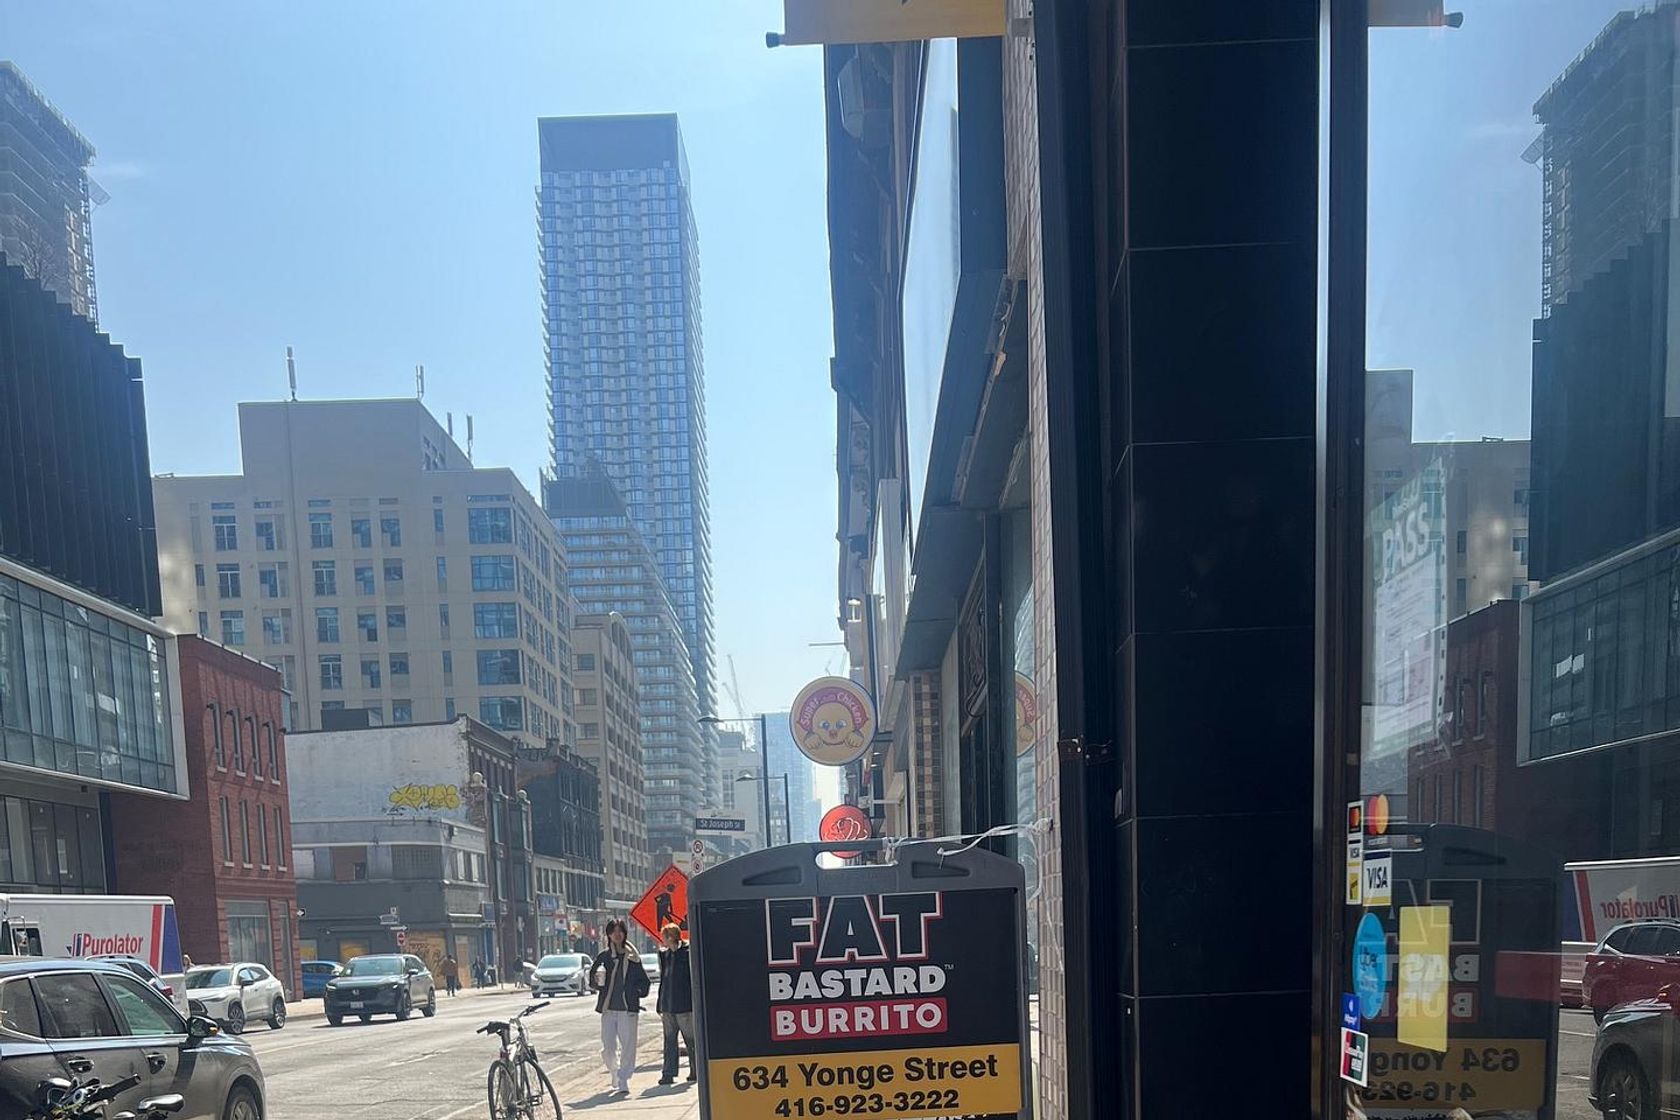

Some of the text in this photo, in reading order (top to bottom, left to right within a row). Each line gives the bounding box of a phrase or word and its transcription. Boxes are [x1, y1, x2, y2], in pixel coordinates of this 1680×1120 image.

[709, 819, 734, 829] Joseph
[1366, 867, 1388, 889] VISA
[82, 932, 144, 956] Purolator
[764, 891, 943, 966] FAT
[769, 964, 946, 1001] BASTARD
[775, 1002, 942, 1037] BURRITO
[733, 1053, 999, 1092] 634 Yonge Street
[775, 1089, 960, 1118] 416-923-3222
